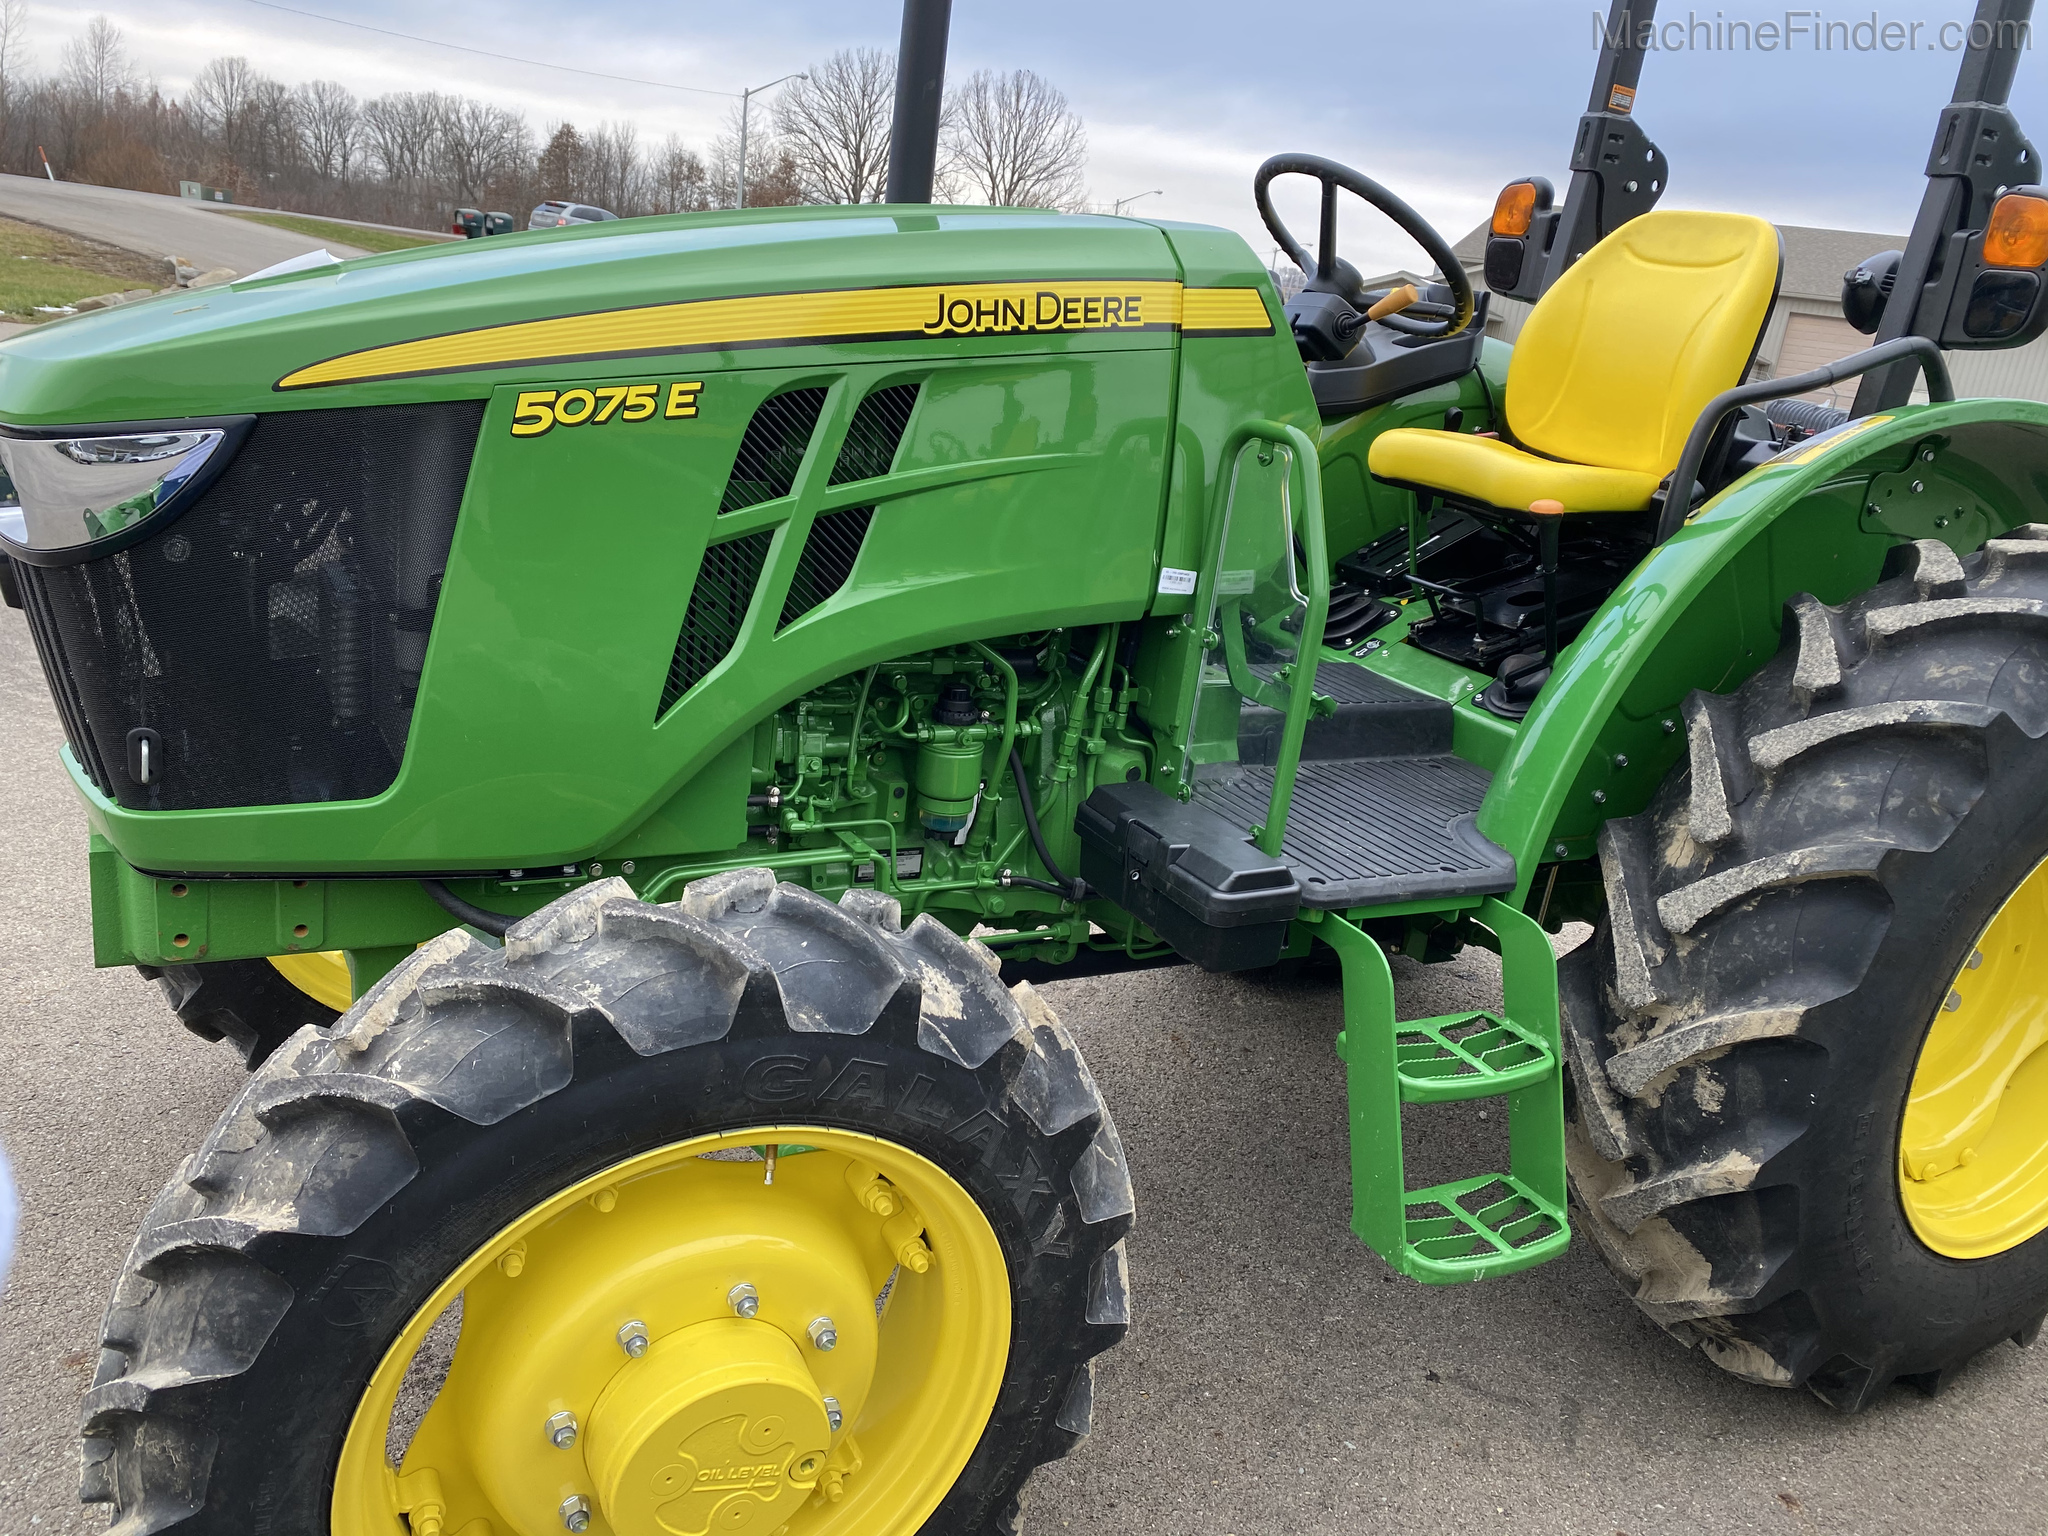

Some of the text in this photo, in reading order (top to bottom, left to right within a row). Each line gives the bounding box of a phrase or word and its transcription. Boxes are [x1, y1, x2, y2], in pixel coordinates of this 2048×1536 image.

[923, 291, 1143, 331] JOHN DEERE
[510, 381, 704, 438] 5075 E
[742, 1054, 1073, 1259] GALAXY
[697, 1464, 781, 1482] OIL LEVEL
